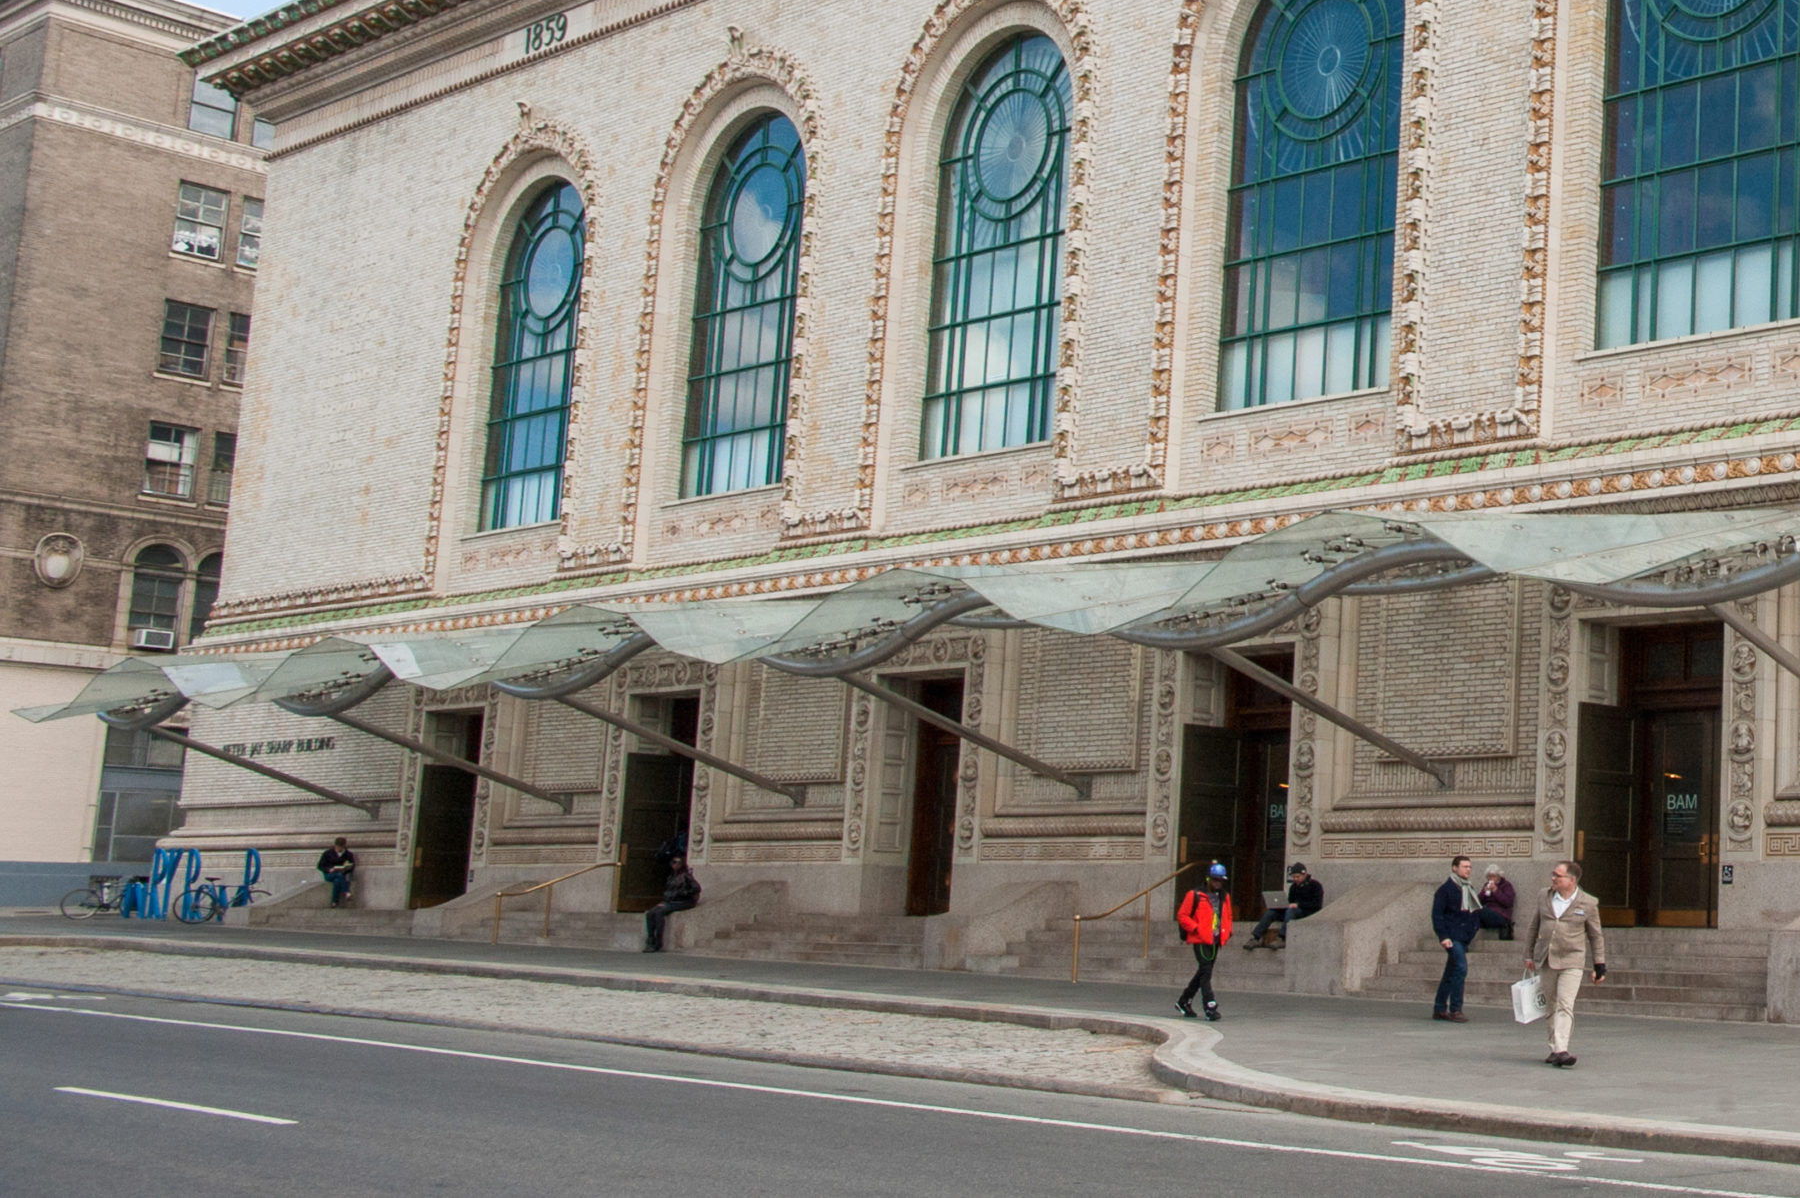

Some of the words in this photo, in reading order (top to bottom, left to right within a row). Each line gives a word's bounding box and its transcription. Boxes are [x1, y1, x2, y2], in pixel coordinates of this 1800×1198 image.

[525, 12, 568, 54] 1859
[1667, 794, 1698, 810] BAM
[1270, 804, 1287, 818] BA
